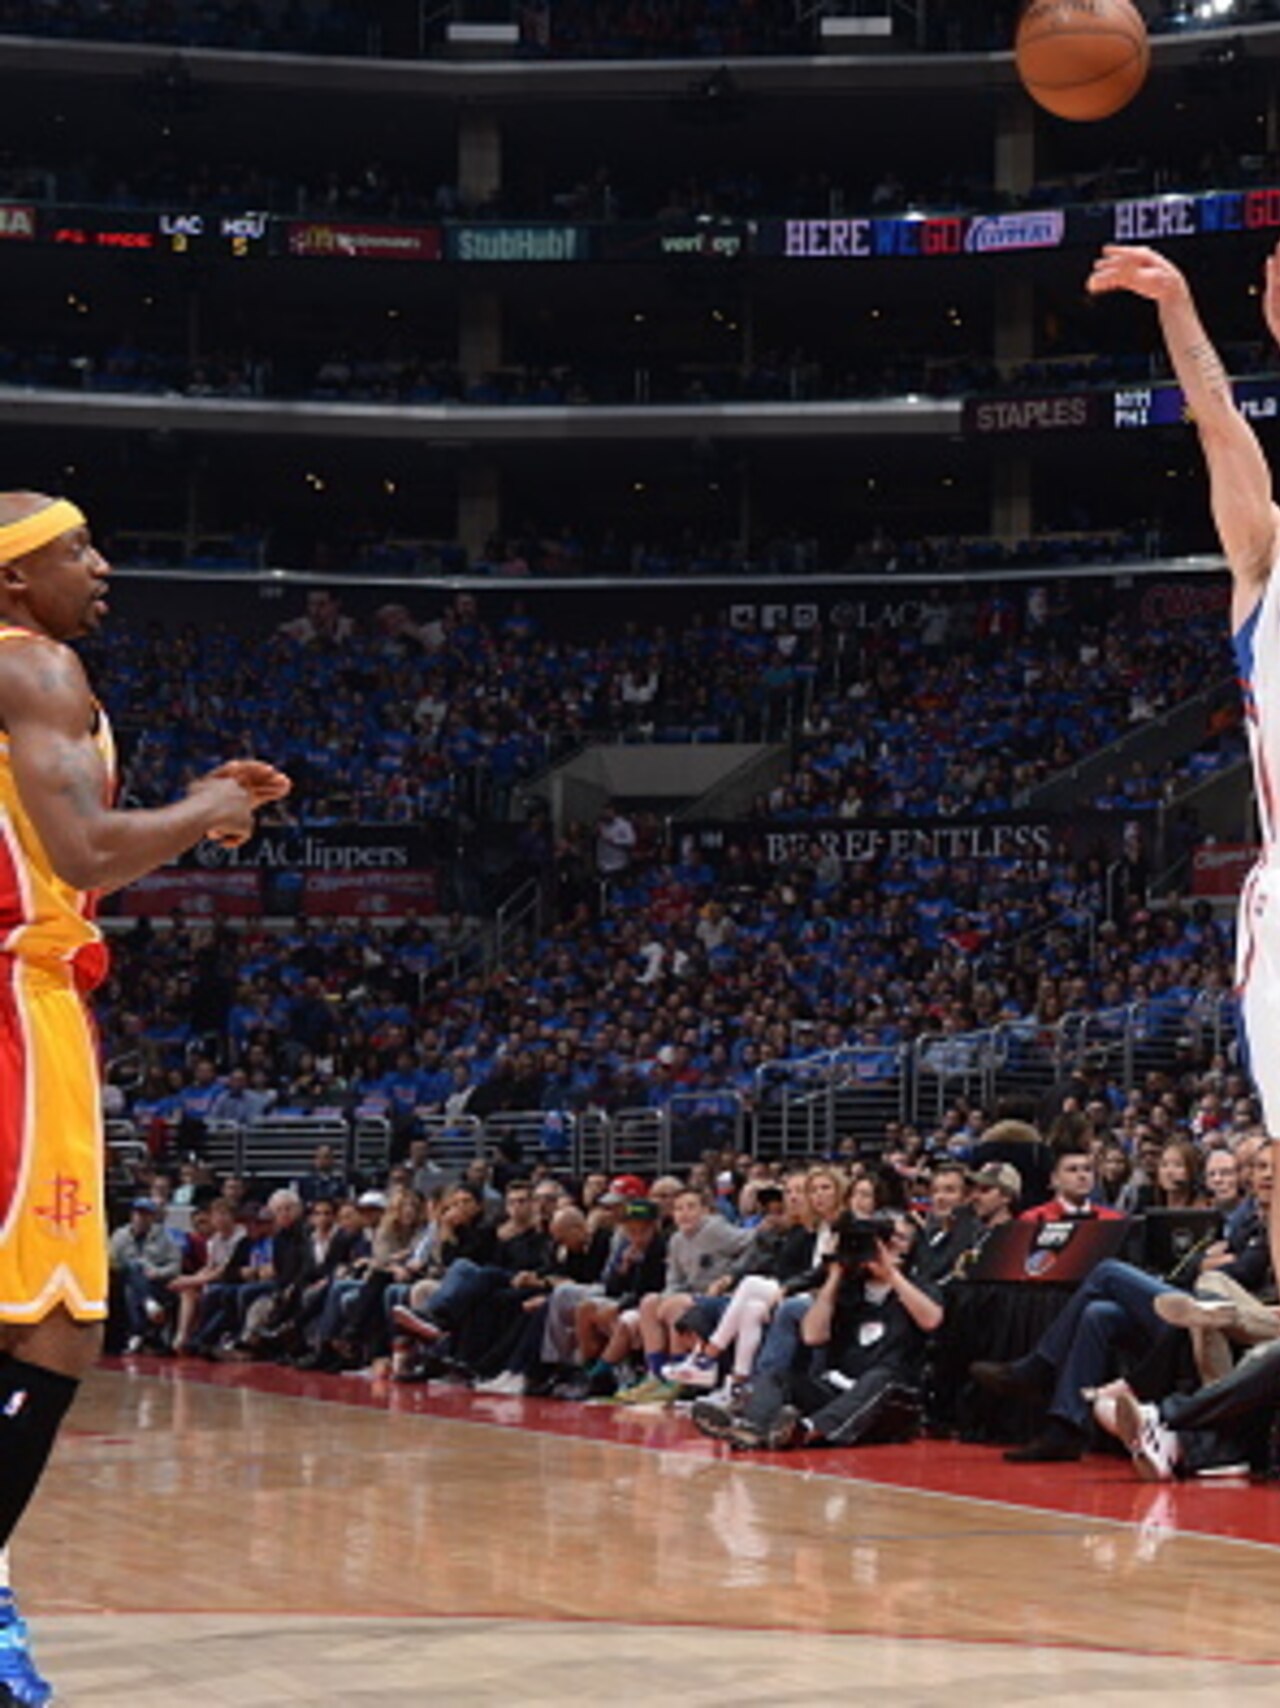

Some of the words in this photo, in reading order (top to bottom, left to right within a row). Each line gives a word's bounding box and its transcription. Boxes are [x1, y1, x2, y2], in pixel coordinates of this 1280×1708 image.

[159, 213, 203, 236] LAC
[220, 214, 267, 240] HOU
[1113, 197, 1196, 241] HERE
[1197, 194, 1244, 231] WE
[457, 227, 575, 260] StubHub!
[785, 219, 869, 257] HERE
[874, 218, 919, 257] WE
[920, 217, 962, 256] GO
[974, 398, 1085, 431] STAPLES
[1112, 407, 1146, 429] PHI
